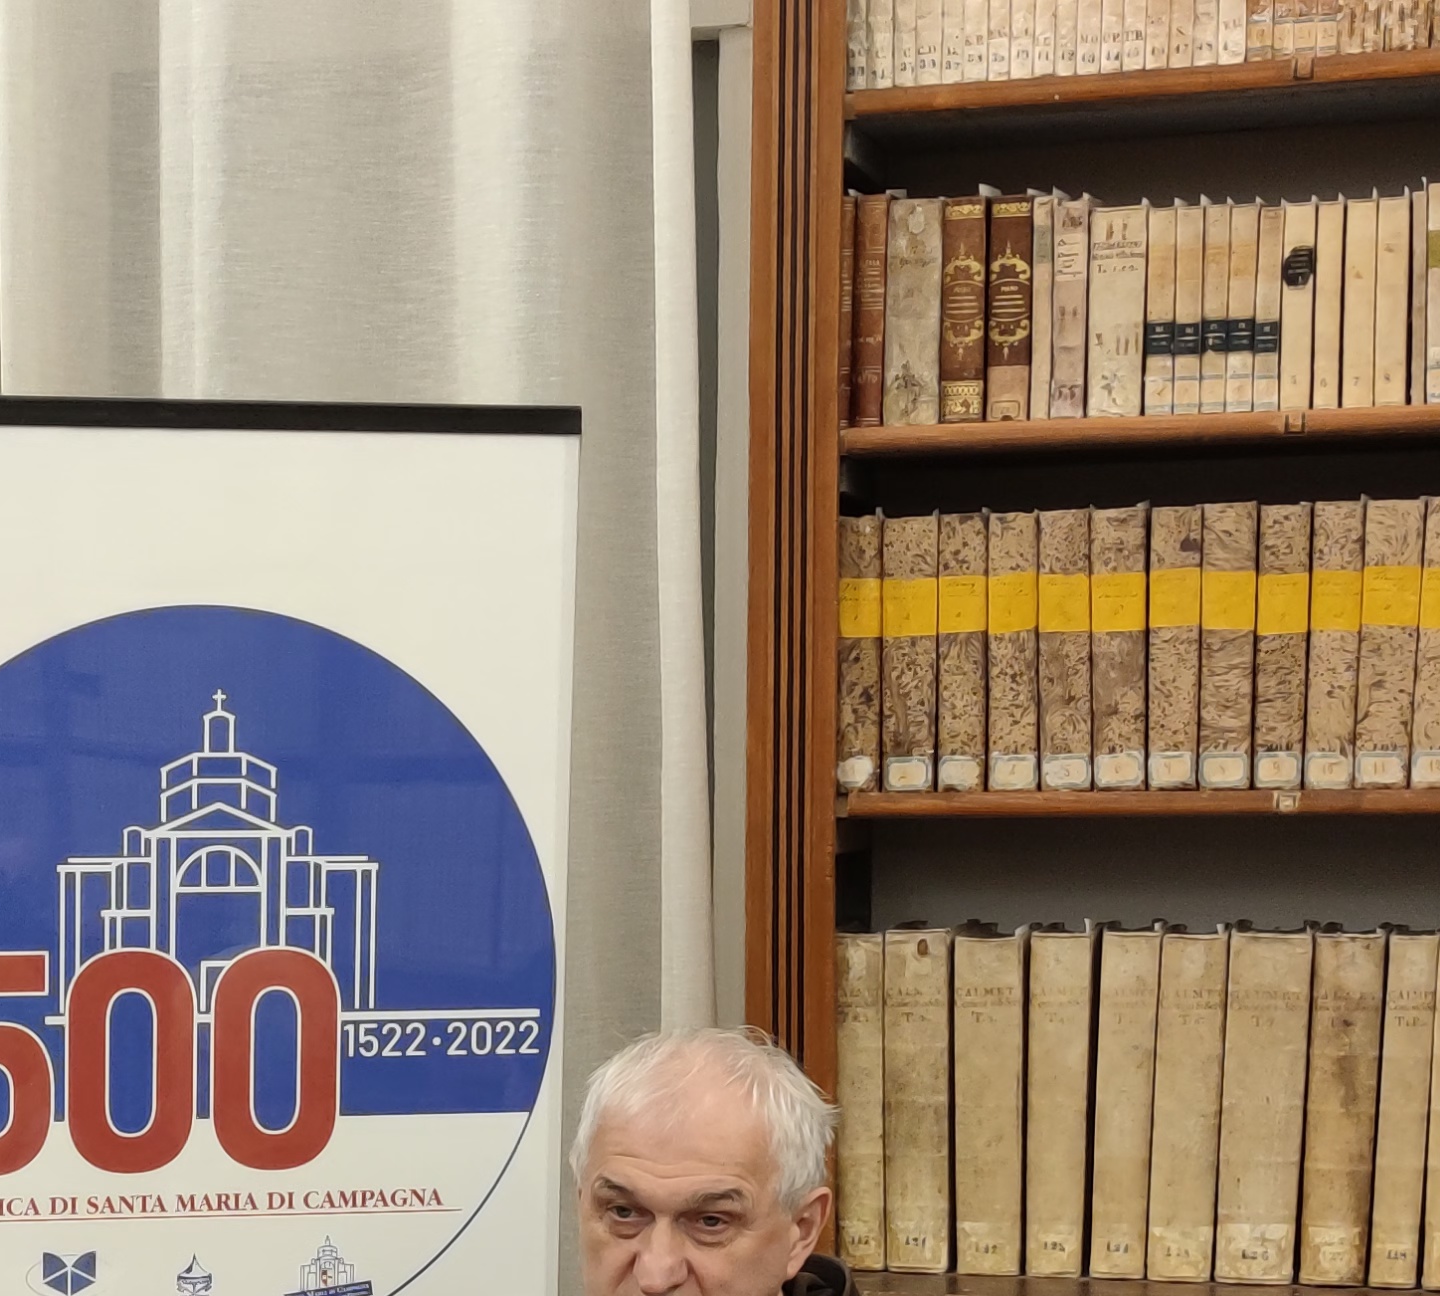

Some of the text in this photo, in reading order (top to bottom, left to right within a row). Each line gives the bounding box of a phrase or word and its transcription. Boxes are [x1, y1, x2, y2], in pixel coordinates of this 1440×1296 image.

[50, 1195, 79, 1217] DI
[86, 1192, 168, 1215] SANTA
[175, 1190, 259, 1213] MARIA
[267, 1189, 295, 1211] DI
[303, 1187, 444, 1211] CAMPAGNA
